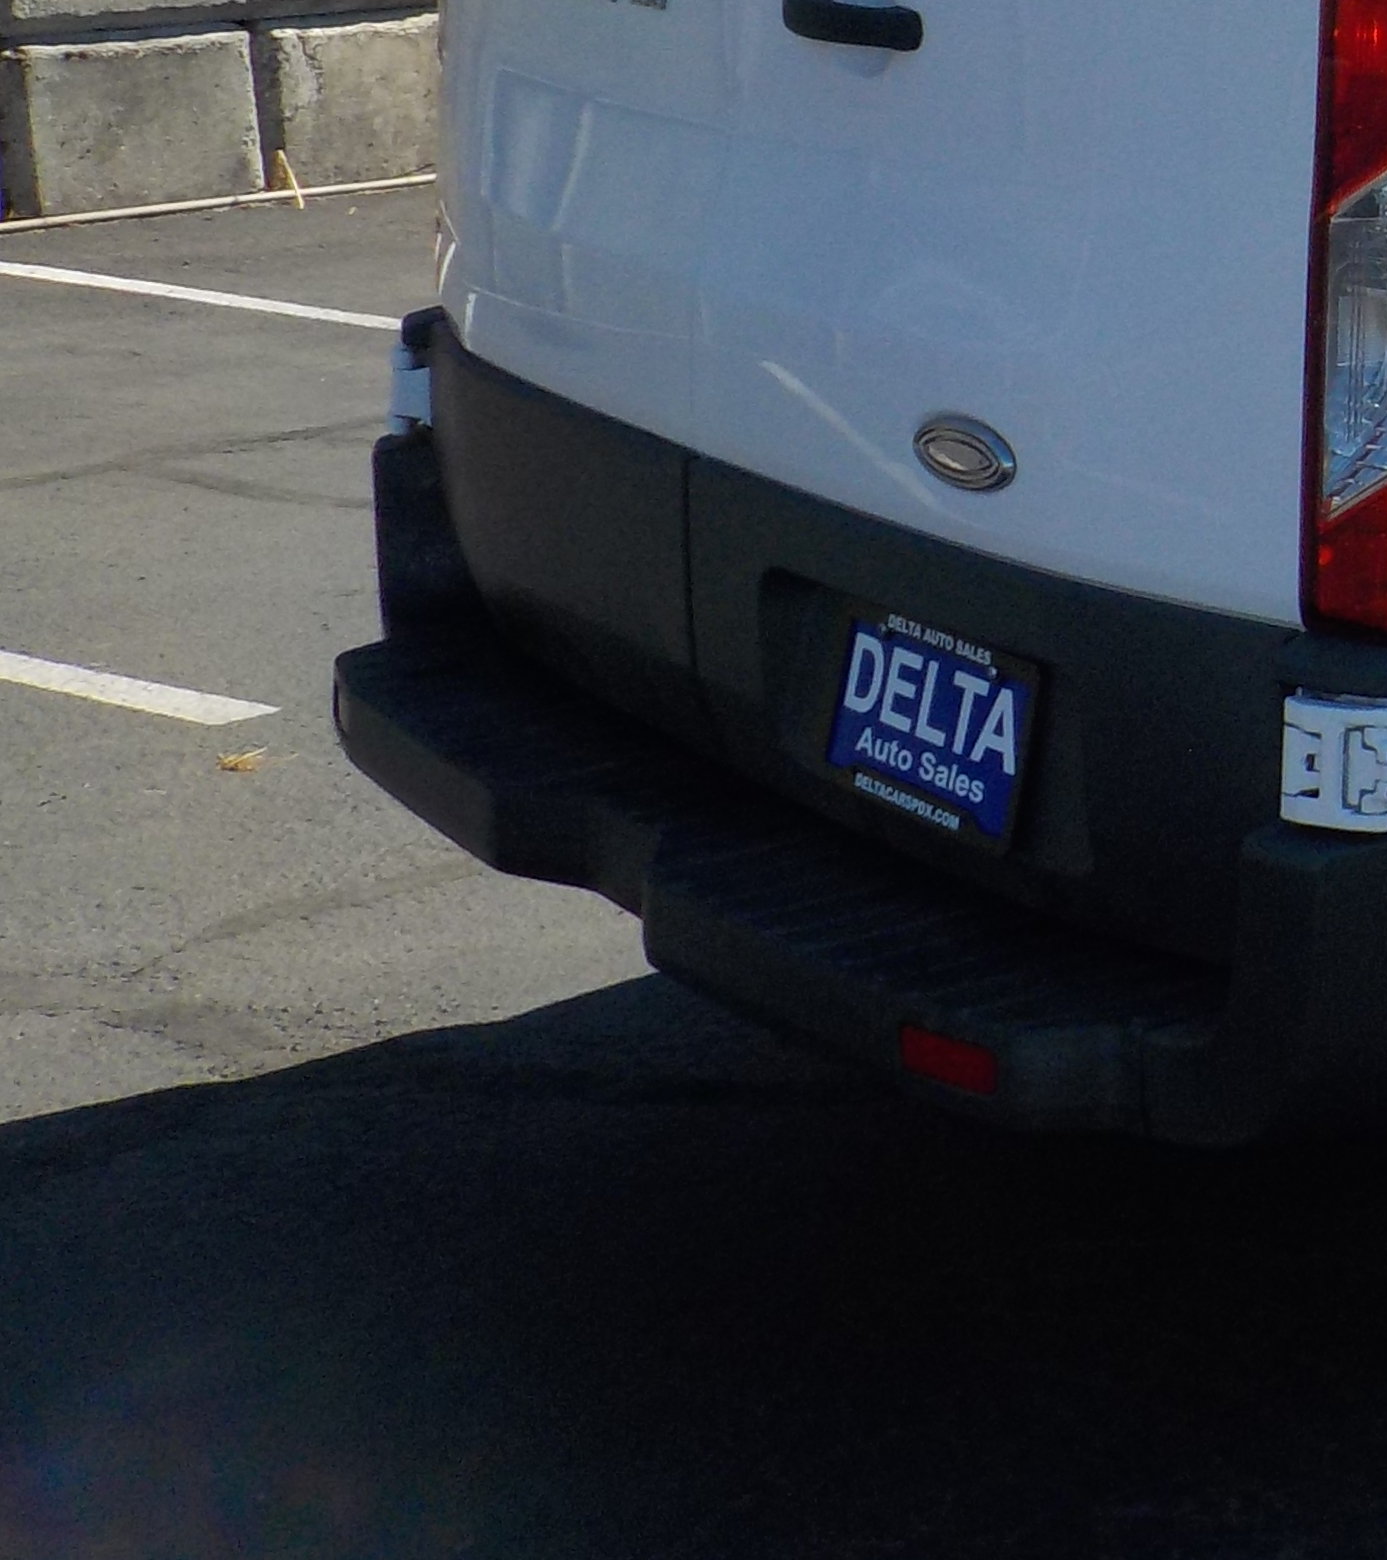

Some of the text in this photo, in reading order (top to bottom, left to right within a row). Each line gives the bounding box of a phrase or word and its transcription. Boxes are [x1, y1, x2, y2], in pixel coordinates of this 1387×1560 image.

[887, 613, 993, 666] DELTA AUTO SALES
[843, 631, 1017, 777] DELTA
[854, 727, 986, 804] Auto Sales
